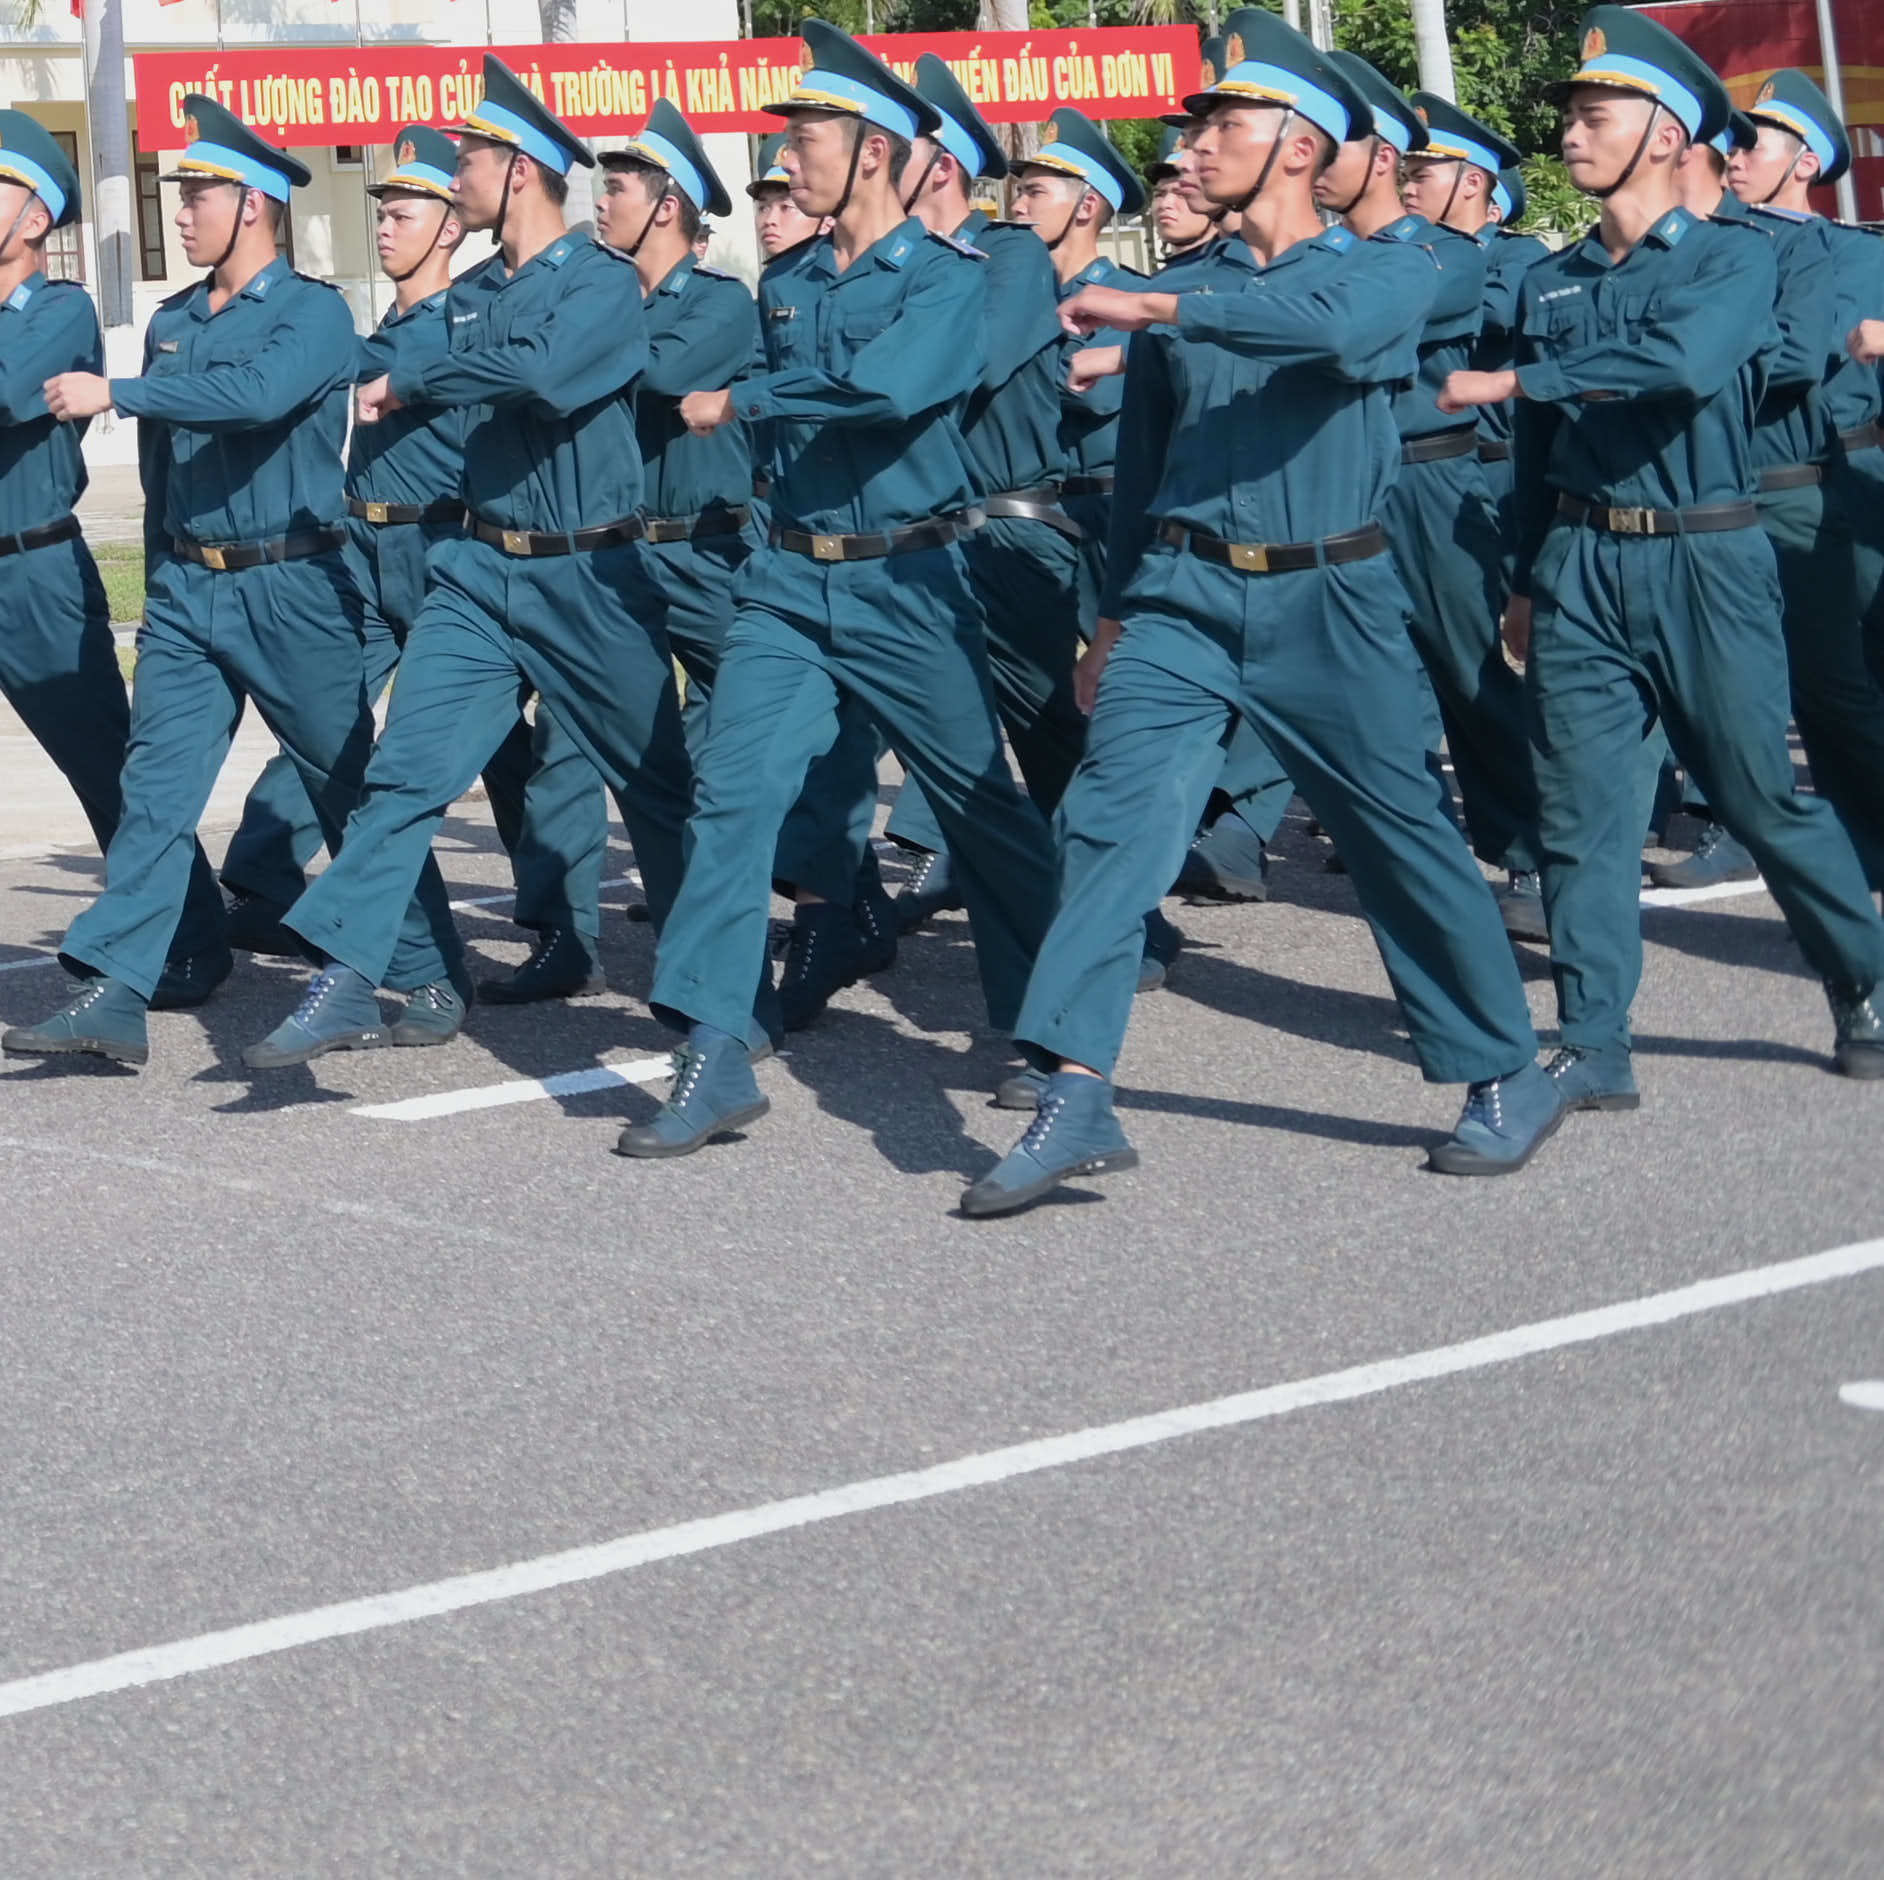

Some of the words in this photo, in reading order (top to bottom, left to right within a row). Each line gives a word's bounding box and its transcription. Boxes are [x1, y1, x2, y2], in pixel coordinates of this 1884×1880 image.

[169, 63, 233, 129] CẤT
[240, 73, 324, 135] LƯỢNG
[329, 67, 381, 123] ĐÀO
[550, 59, 647, 118] TRƯỜNG
[686, 52, 736, 114] KHẢ
[1002, 41, 1049, 103] ĐẤU
[1053, 41, 1100, 100] CỦA
[1101, 49, 1149, 98] ĐƠN
[1150, 52, 1176, 106] VỊ
